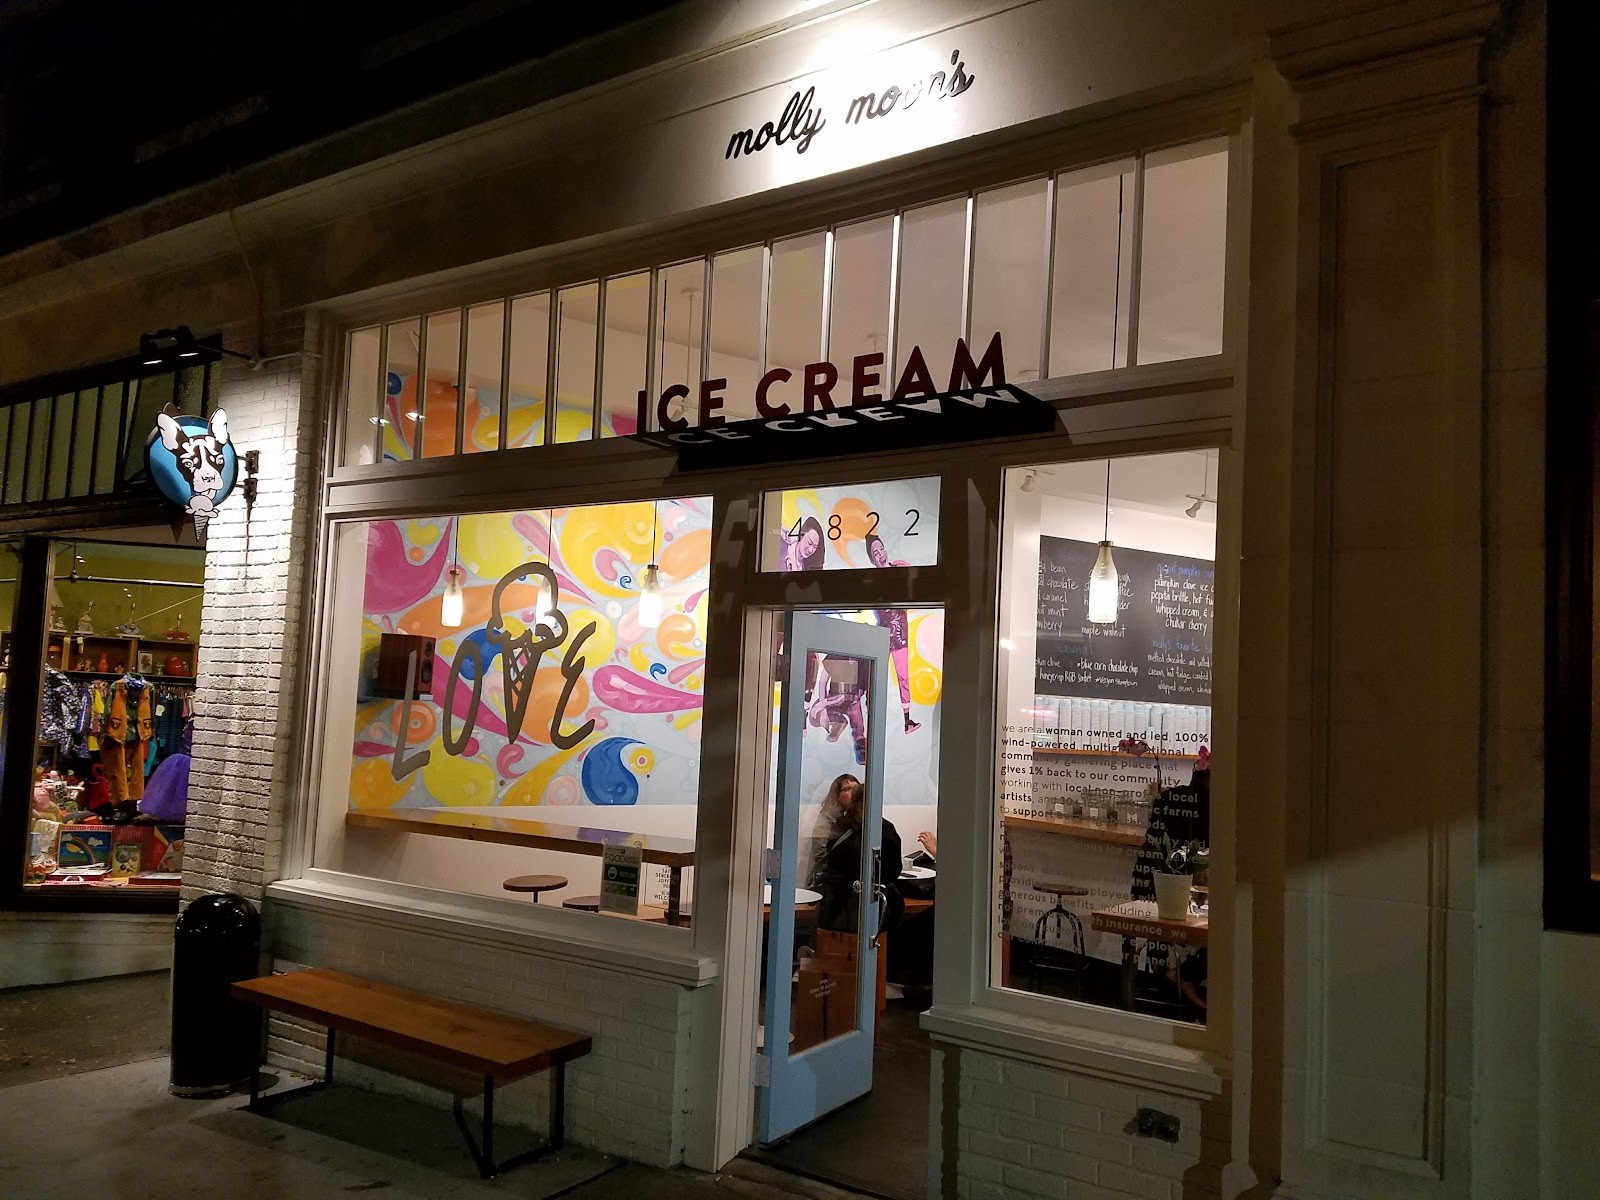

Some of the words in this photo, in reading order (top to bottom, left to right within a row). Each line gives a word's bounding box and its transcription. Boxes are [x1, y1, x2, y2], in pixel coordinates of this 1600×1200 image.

[725, 86, 826, 159] molly
[845, 49, 975, 124] moon's
[637, 377, 727, 433] ICE
[755, 331, 1007, 420] CREAM
[1046, 576, 1078, 590] chocolate
[1154, 578, 1180, 592] pumpkin
[1183, 579, 1196, 590] clove
[1043, 592, 1068, 604] caramel
[1151, 590, 1170, 604] pepita
[1192, 592, 1203, 604] hot
[1048, 604, 1068, 617] mint
[1155, 602, 1181, 618] whipped
[1082, 624, 1100, 638] maple
[1103, 624, 1127, 638] walnut
[1188, 618, 1208, 637] cherry
[1045, 727, 1083, 736] woman
[1086, 729, 1122, 738] owned
[1126, 730, 1147, 740] and
[1150, 730, 1172, 743] led,
[1175, 732, 1208, 743] 100%
[1064, 757, 1118, 770] gathering
[1121, 760, 1152, 770] place
[1000, 764, 1026, 776] gives
[1029, 766, 1044, 776] 1%
[1047, 767, 1072, 778] back
[1075, 769, 1086, 779] to
[1089, 772, 1108, 781] our
[1000, 778, 1038, 793] working
[1042, 781, 1062, 792] with
[1066, 782, 1092, 793] local
[1168, 790, 1198, 803] local
[1000, 792, 1034, 804] artists,
[1164, 806, 1199, 818] farms
[1000, 804, 1010, 814] to
[1012, 808, 1053, 818] support
[1126, 848, 1164, 860] cream
